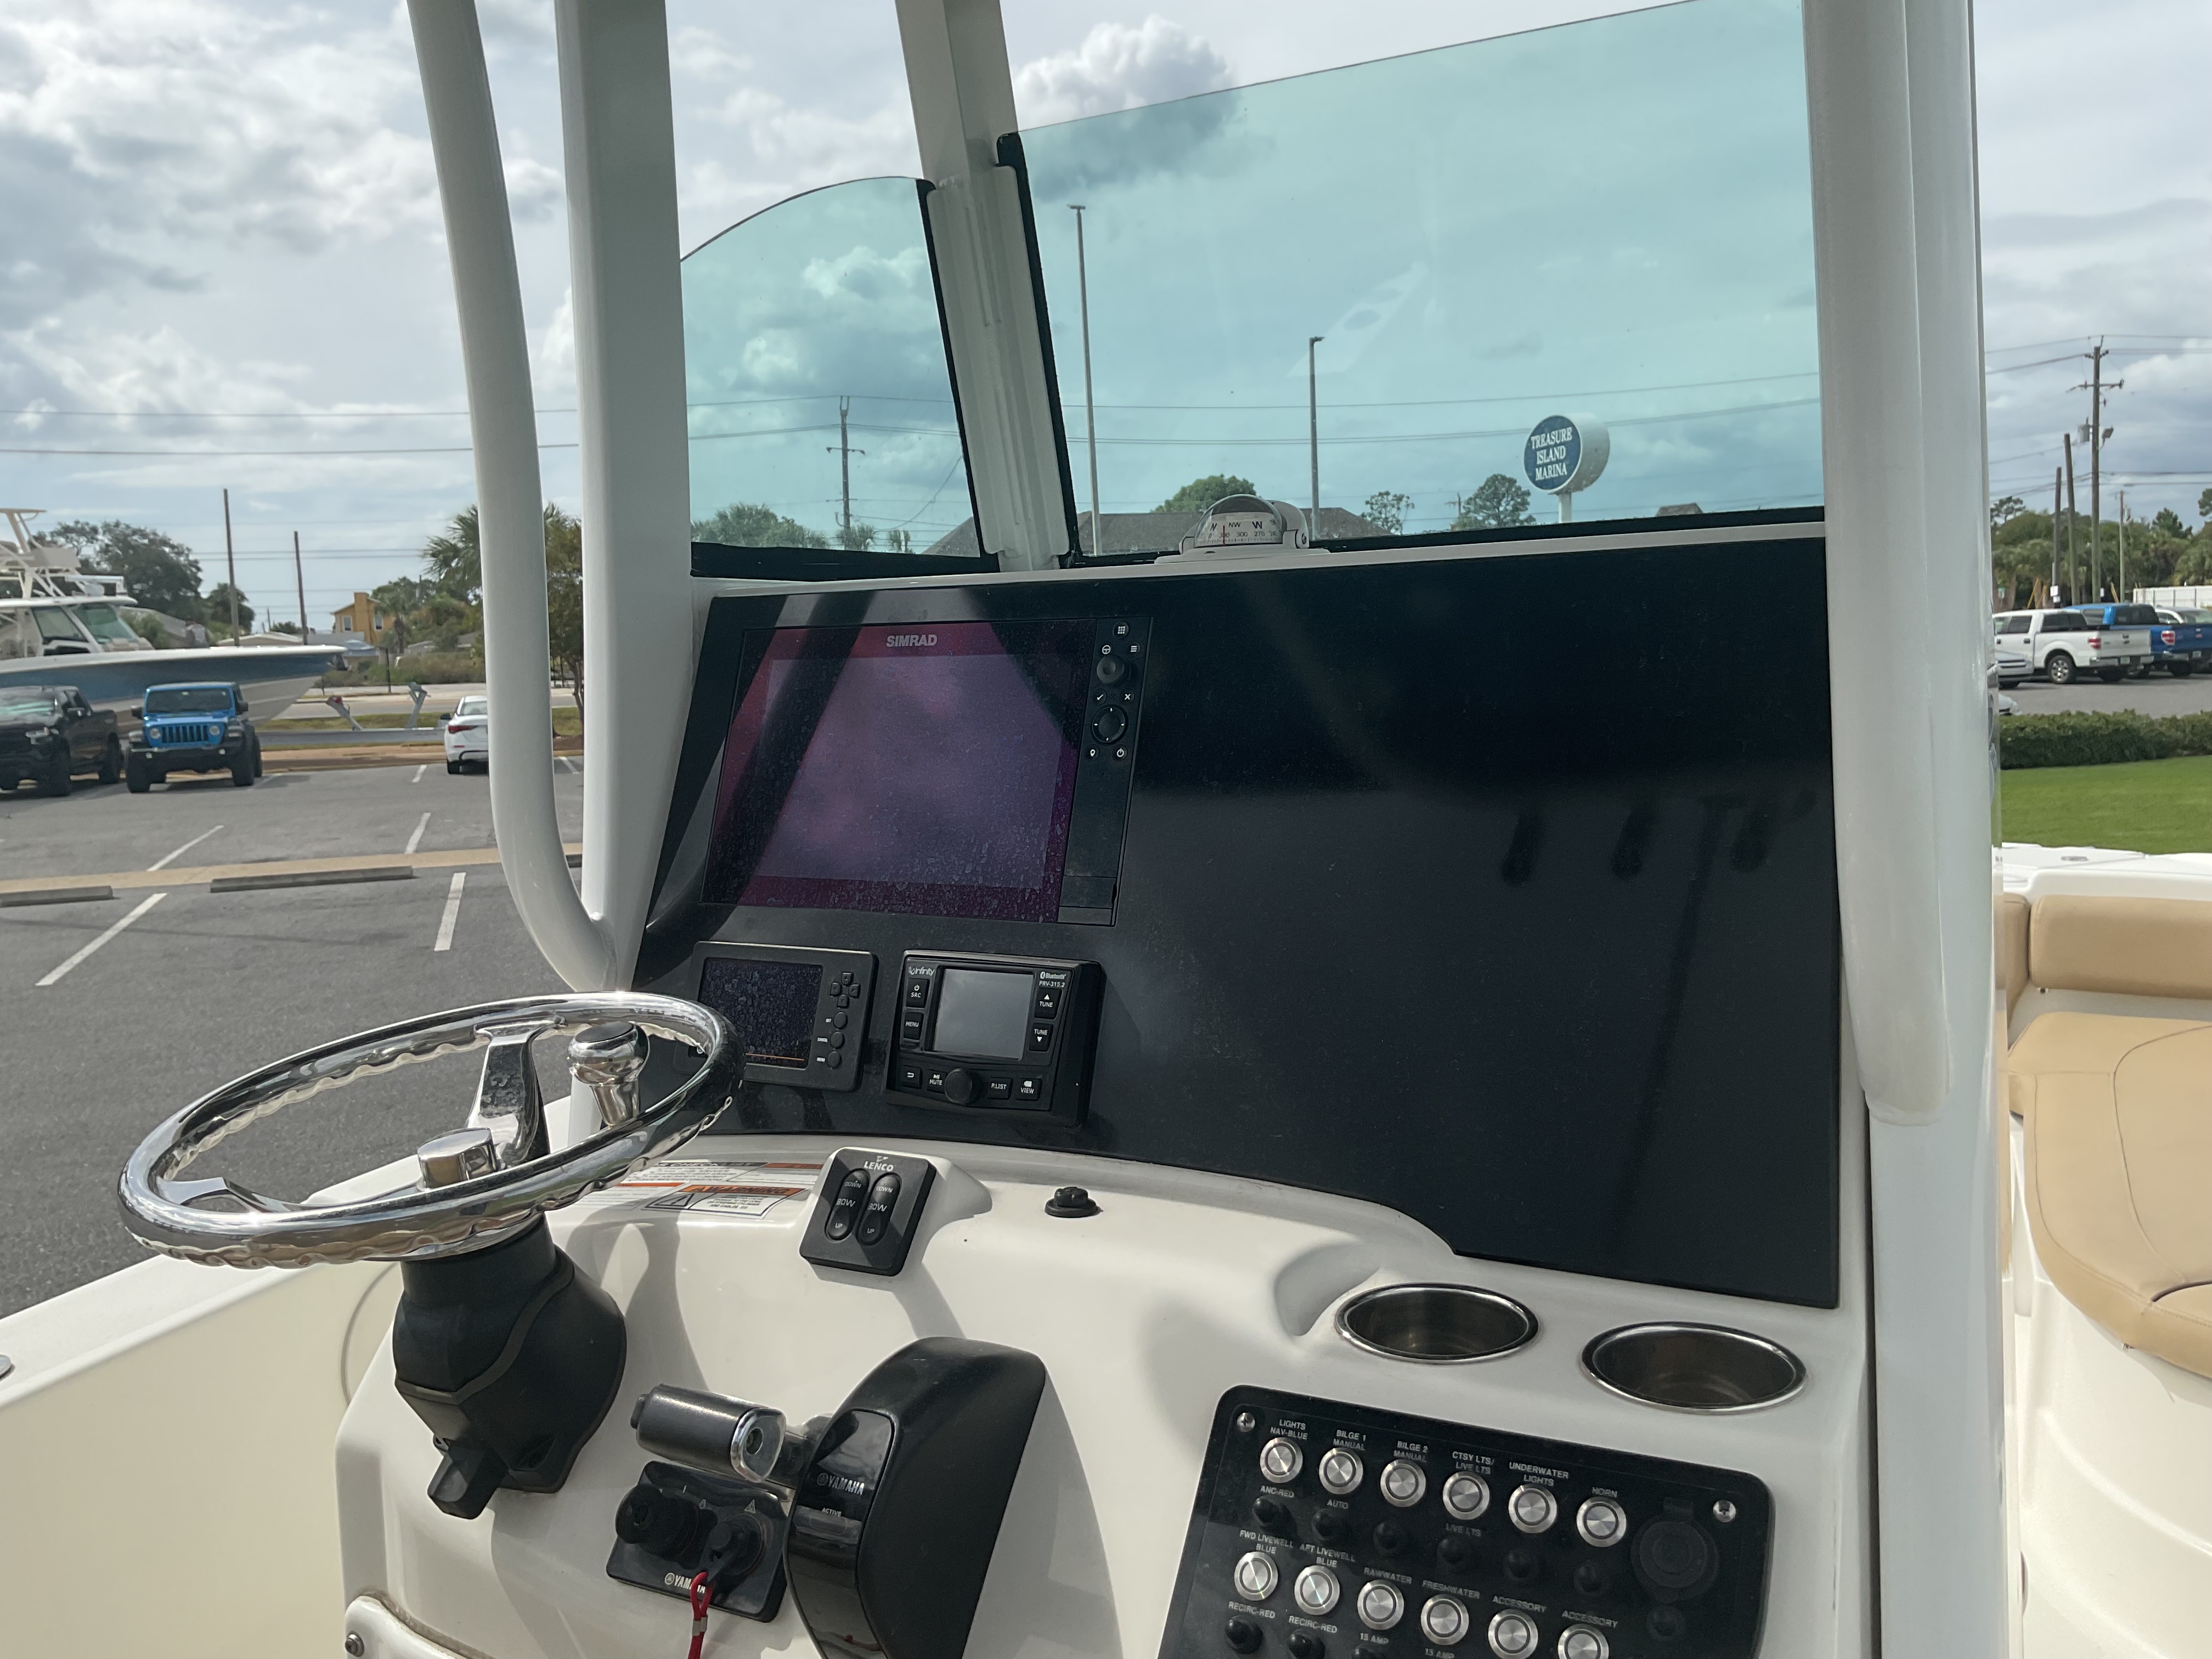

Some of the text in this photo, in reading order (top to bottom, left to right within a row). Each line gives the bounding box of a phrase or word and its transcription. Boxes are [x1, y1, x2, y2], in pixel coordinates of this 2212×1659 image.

[1531, 427, 1572, 449] TREASURE
[1537, 445, 1566, 465] ISLAND
[1536, 462, 1567, 481] MARINA
[1210, 523, 1217, 532] N
[886, 634, 938, 647] SIMRAD
[863, 1160, 894, 1171] LENCO
[836, 1198, 855, 1207] BOW
[868, 1203, 887, 1211] BOW
[1279, 1419, 1306, 1430] LIGHTS
[1270, 1427, 1308, 1440] NAV-BLUE
[1336, 1430, 1359, 1440] BILGE
[1333, 1439, 1365, 1451] MANUAL
[1397, 1441, 1421, 1452] BILGE
[1393, 1450, 1426, 1462] MANUAL
[1452, 1452, 1474, 1462] CTSY
[1455, 1462, 1491, 1475] LIVE LTS
[1509, 1462, 1569, 1479] UNDERWATER
[828, 1475, 865, 1496] YAMAHA
[1523, 1474, 1554, 1487] LIGHTS
[1260, 1485, 1295, 1498] ANC-RED
[1592, 1487, 1618, 1498] HORN
[1327, 1499, 1348, 1509] AUTO
[1465, 1527, 1481, 1536] LTS
[1239, 1530, 1294, 1548] FWD LIVEWELL
[1256, 1543, 1277, 1554] BLUE
[1300, 1543, 1356, 1562] AFT LIVEWELL
[1316, 1556, 1337, 1567] BLUE
[1364, 1567, 1412, 1585] RAWWATER
[674, 1575, 706, 1594] YAMA
[1422, 1580, 1480, 1599] FRESHWATER
[1228, 1601, 1276, 1618] RECIRC-RED
[1492, 1595, 1547, 1613] ACCESSORY
[1289, 1615, 1338, 1633] RECIRC-RED
[1561, 1610, 1618, 1628] ACCESSORY
[1370, 1635, 1389, 1645] AMP
